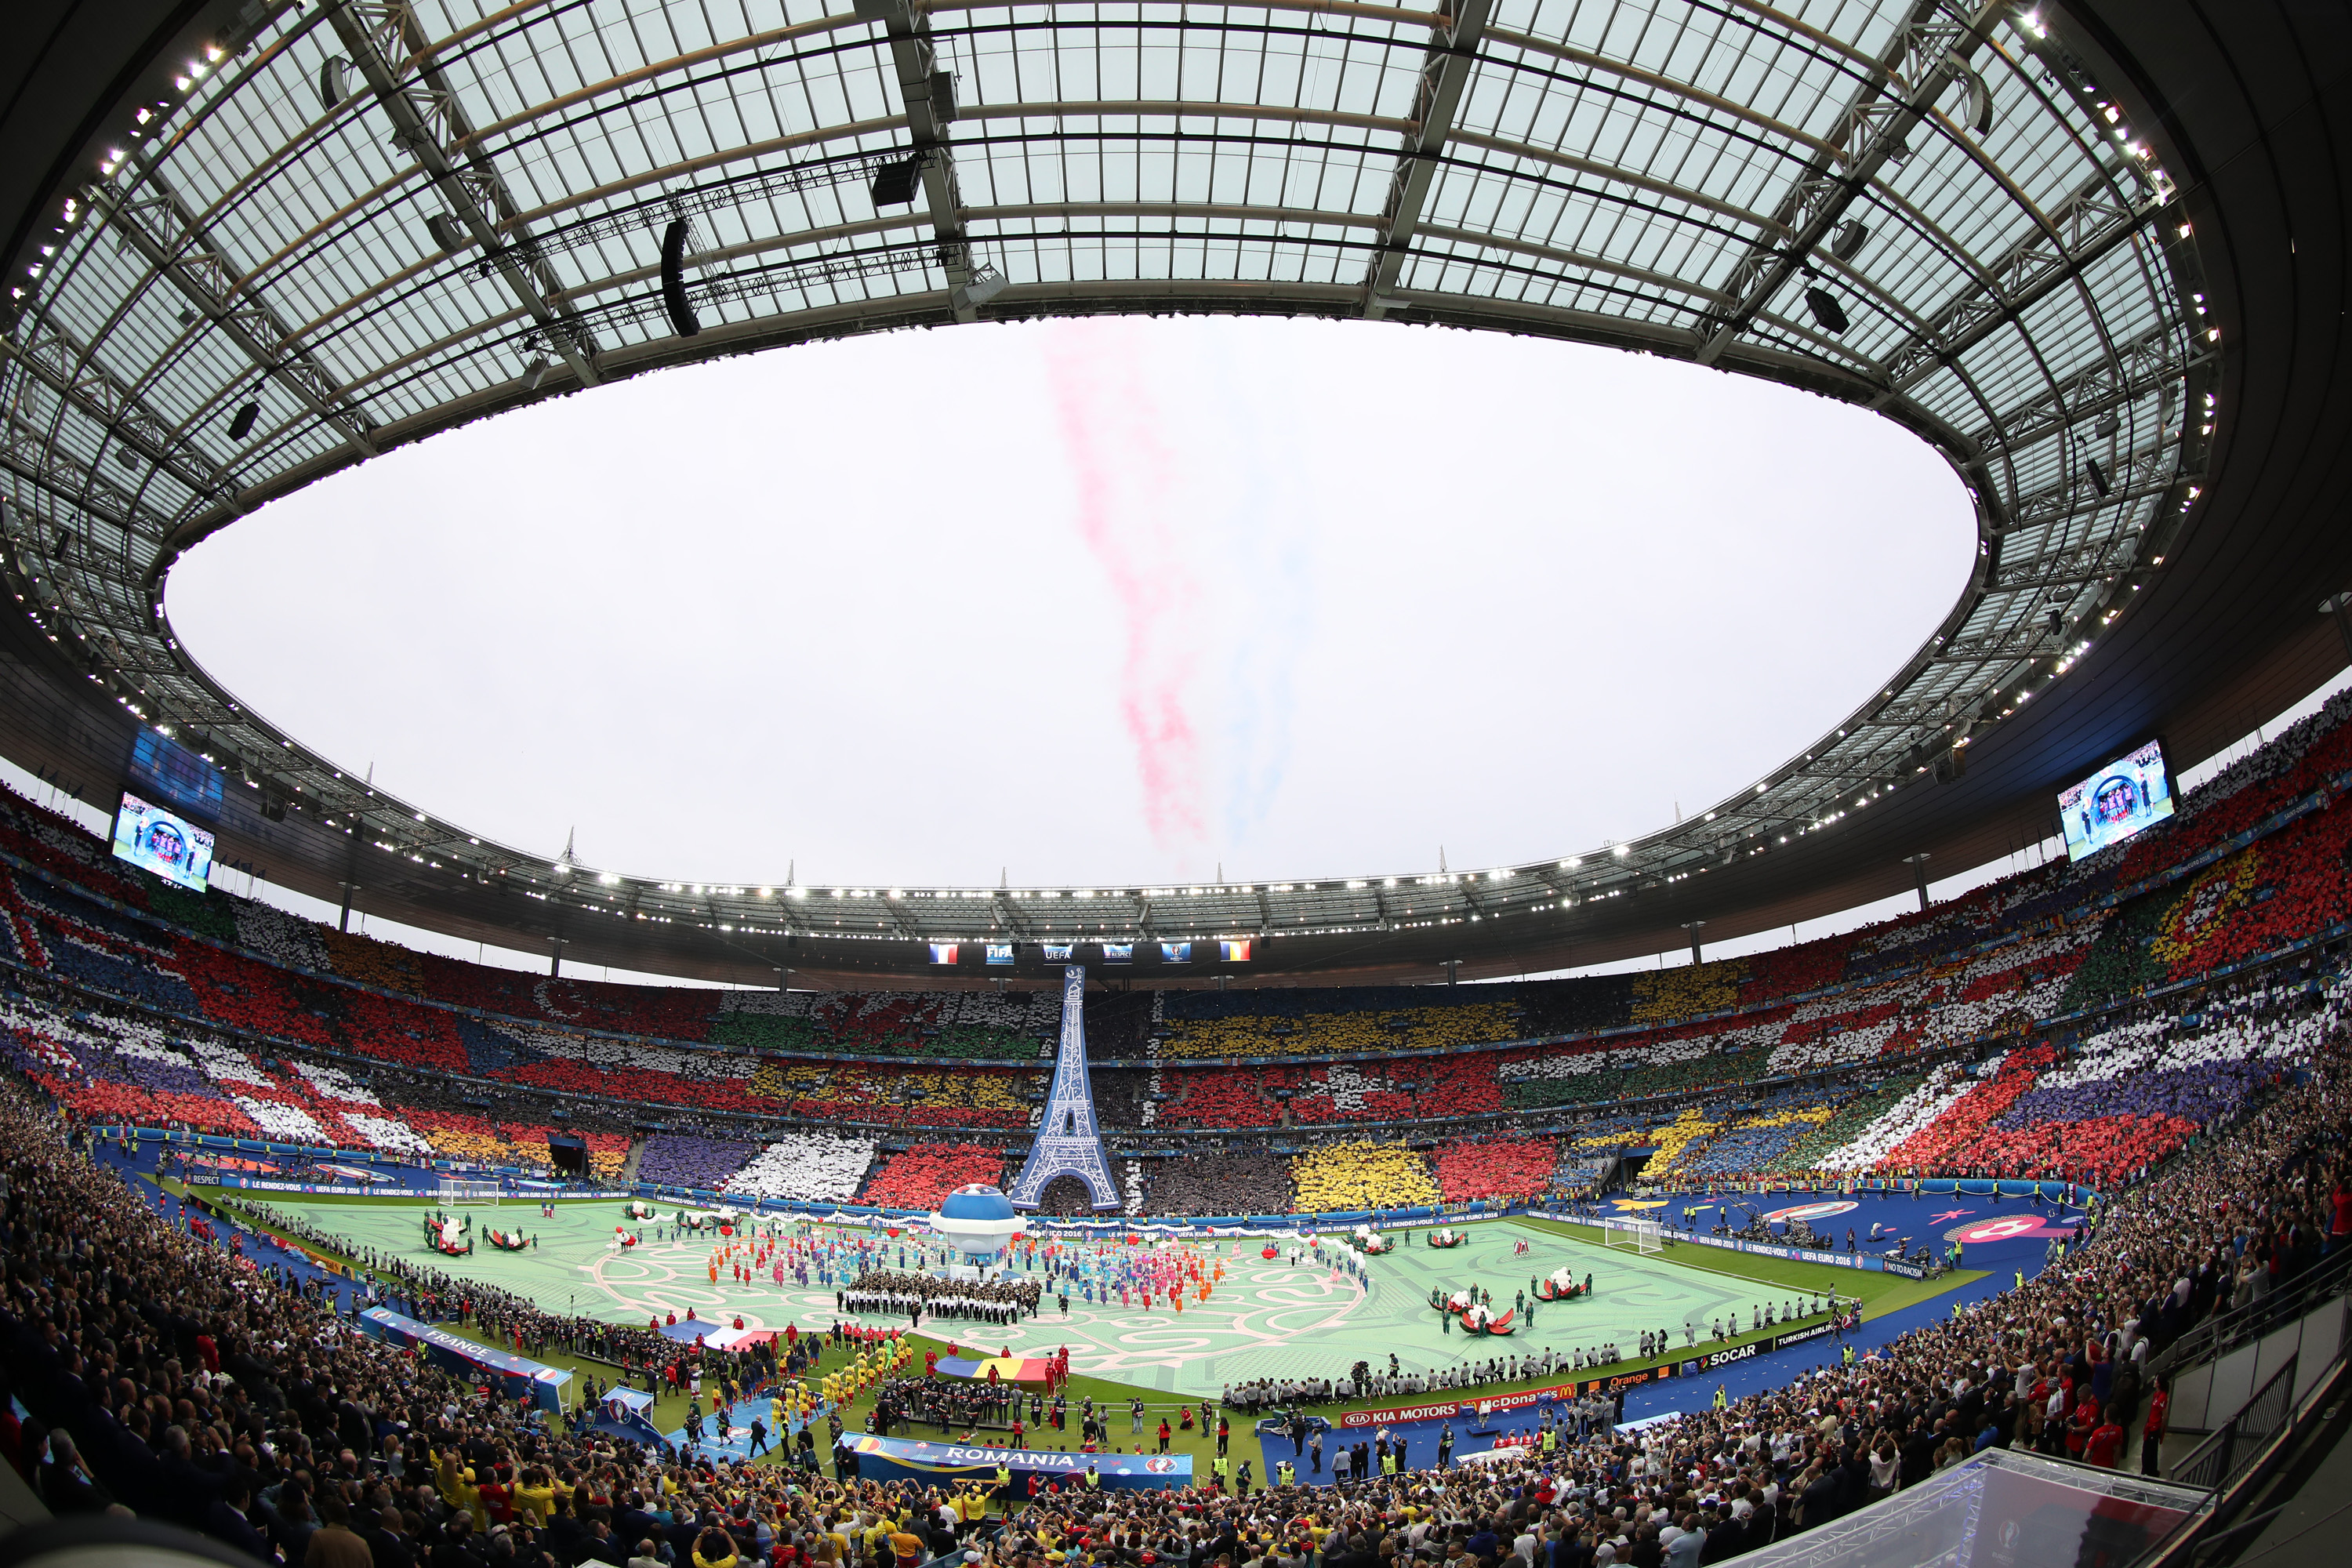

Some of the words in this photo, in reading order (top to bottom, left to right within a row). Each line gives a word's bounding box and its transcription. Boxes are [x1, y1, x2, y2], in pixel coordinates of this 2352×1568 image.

[2284, 803, 2309, 820] SAINT-DENIS
[2188, 859, 2199, 868] EURO
[2200, 854, 2210, 863] 2016
[987, 947, 1014, 958] FIFA
[193, 1175, 220, 1185] RESPECT
[252, 1180, 260, 1188] LE
[261, 1181, 301, 1191] RENDEZ-VOUS
[664, 1196, 696, 1205] RENDEZ-VOUS
[230, 1215, 253, 1234] Probably
[1392, 1219, 1433, 1227] RENDEZ-VOUS
[1699, 1236, 1710, 1245] UEFA
[1711, 1238, 1722, 1247] EURO
[1723, 1240, 1734, 1248] 2016
[1753, 1245, 1787, 1257] RENDEZ-VOUS
[1802, 1251, 1817, 1262] UEFA
[1818, 1254, 1834, 1264] EURO
[1835, 1256, 1851, 1266] 2016
[1888, 1261, 1896, 1271] NO
[1897, 1263, 1904, 1273] TO
[1904, 1265, 1922, 1277] RACISM
[426, 1330, 492, 1357] FRANCE
[1778, 1331, 1809, 1345] TURKISH
[1710, 1344, 1756, 1366] SOCAR
[1610, 1372, 1648, 1386] Orange
[1347, 1415, 1366, 1423] KIA
[1373, 1411, 1396, 1423] KIA
[1400, 1404, 1455, 1419] MOTORS
[946, 1447, 1075, 1467] ROMANIA
